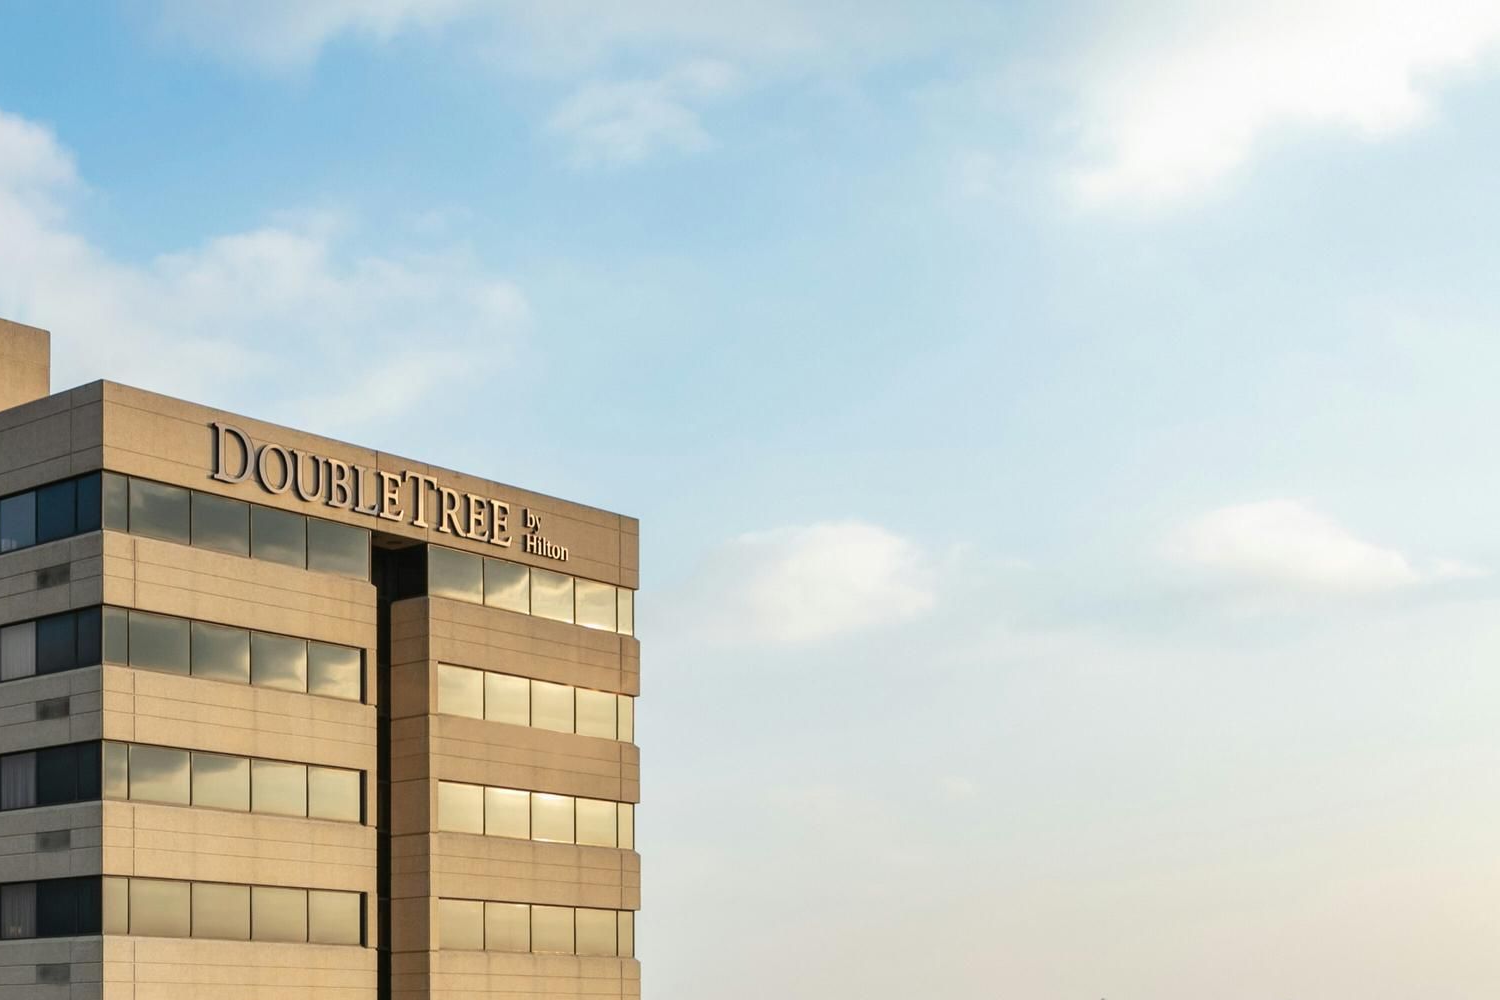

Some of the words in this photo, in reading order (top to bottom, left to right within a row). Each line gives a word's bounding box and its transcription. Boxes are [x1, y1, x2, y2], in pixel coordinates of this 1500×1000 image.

[212, 421, 513, 548] DOUBLETREE
[525, 507, 542, 534] by
[526, 533, 569, 561] Hilton
